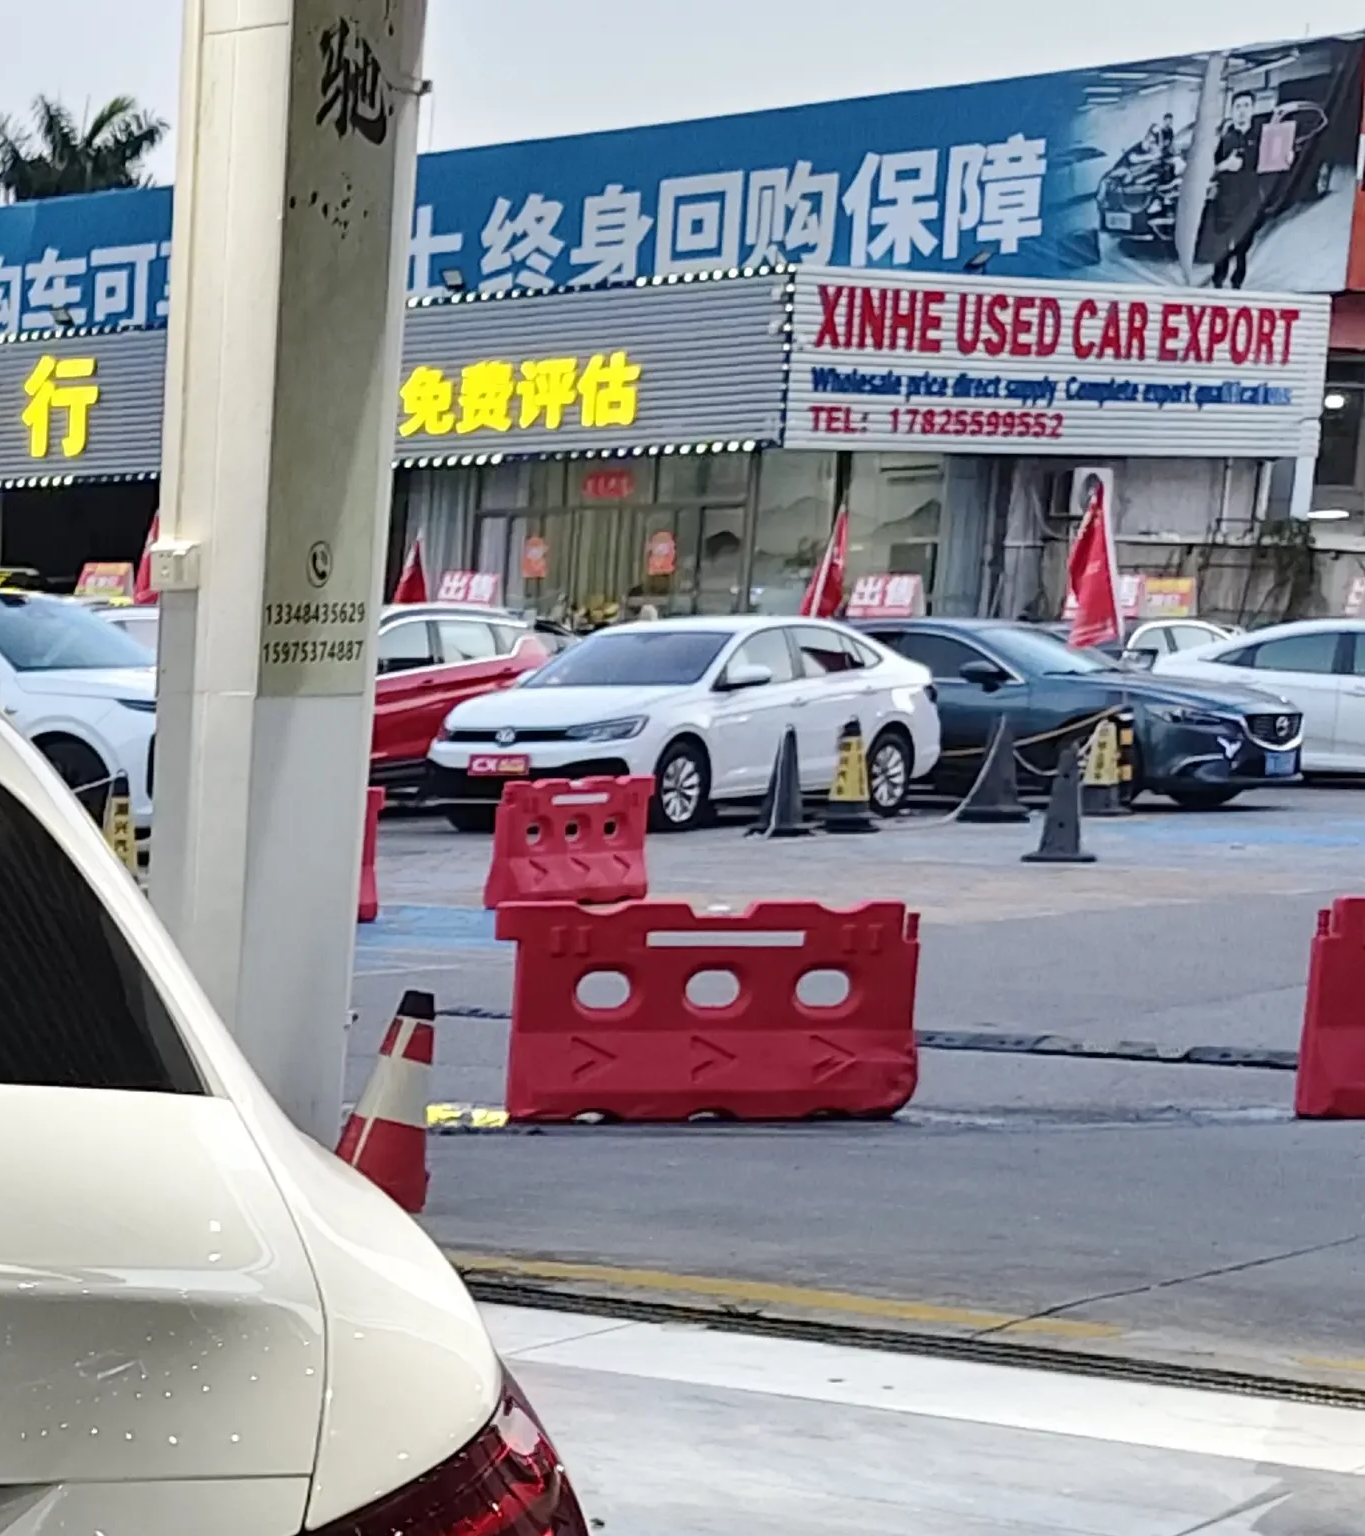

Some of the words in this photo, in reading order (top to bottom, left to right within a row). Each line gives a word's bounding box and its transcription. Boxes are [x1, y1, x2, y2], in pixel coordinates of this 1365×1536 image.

[814, 285, 945, 353] XINHE
[956, 293, 1061, 356] USED
[1072, 299, 1148, 361] CAR
[1158, 303, 1299, 365] EXPORT
[398, 351, 641, 436] 免费评估
[905, 371, 947, 402] price
[888, 407, 1064, 438] 17825599552
